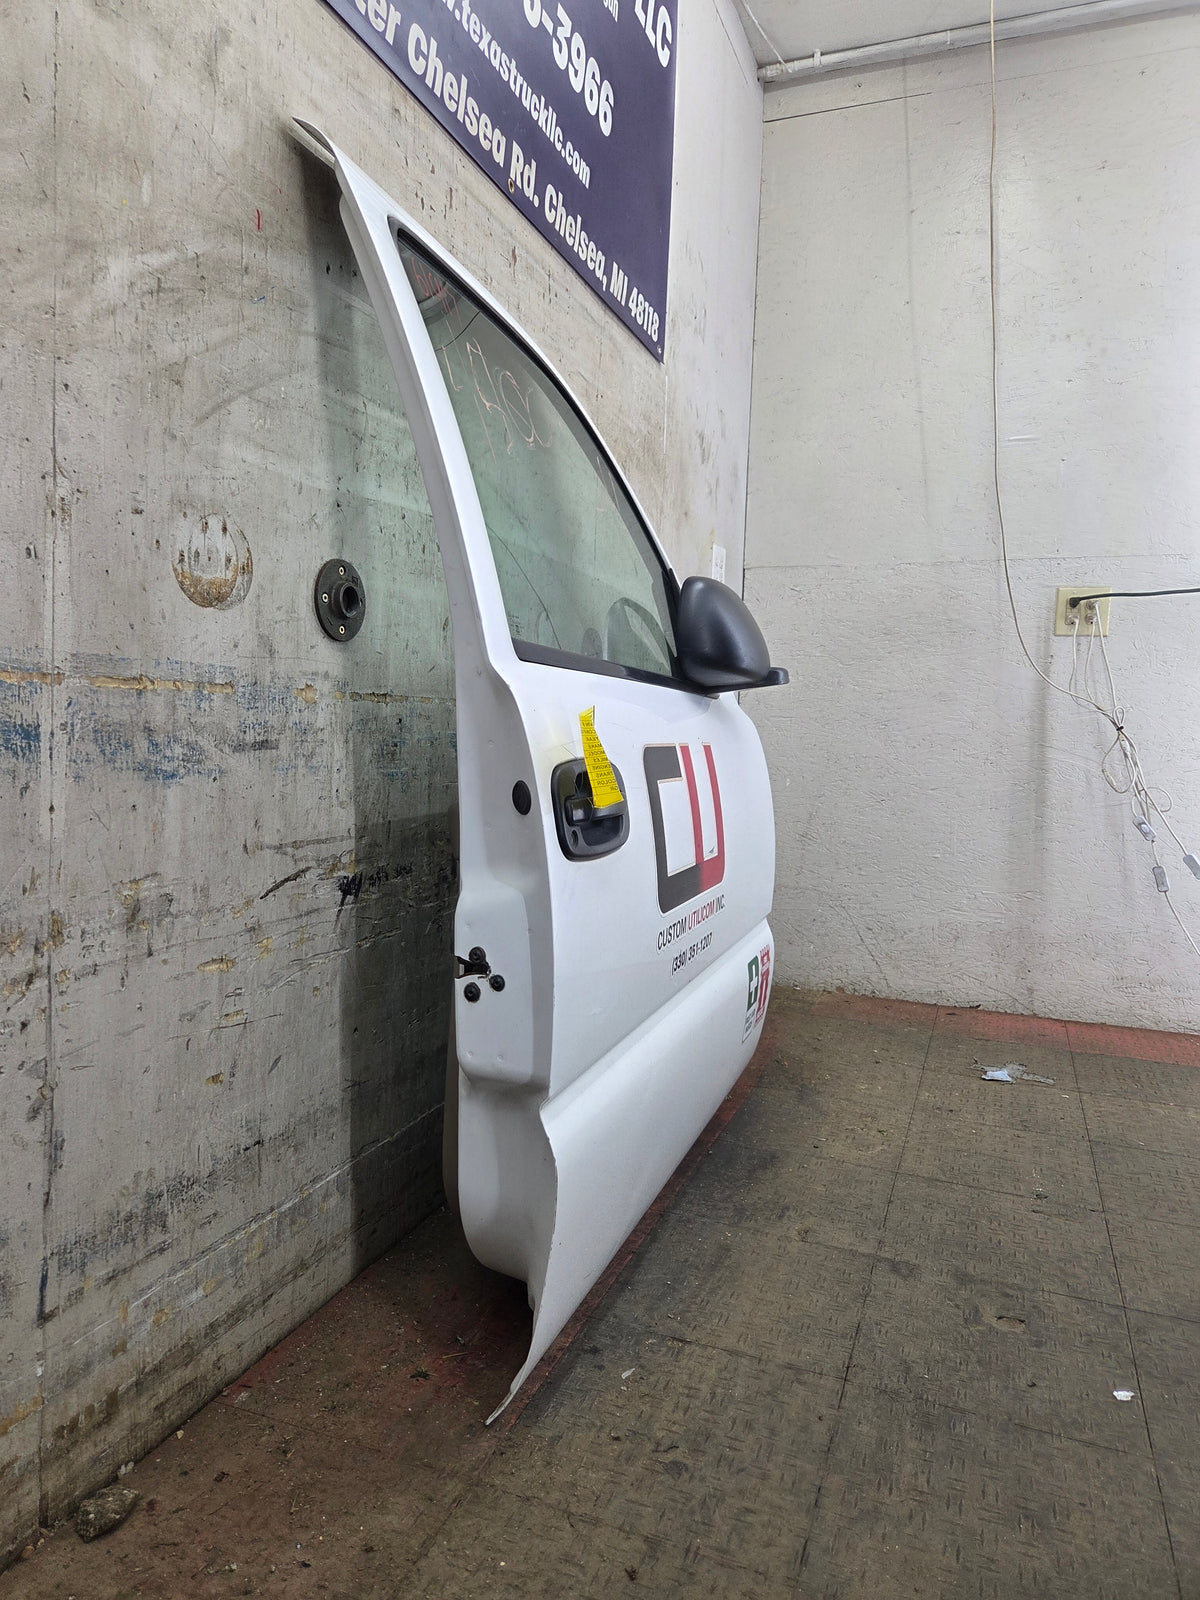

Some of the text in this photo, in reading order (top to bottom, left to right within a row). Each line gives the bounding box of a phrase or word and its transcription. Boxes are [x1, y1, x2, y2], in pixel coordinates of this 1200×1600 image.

[442, 0, 591, 189] .texastruckllc.com
[407, 22, 507, 168] Chelsea
[509, 139, 539, 208] Rd.
[544, 183, 608, 292] Chelsea,
[609, 261, 629, 307] MI
[628, 286, 660, 343] 48118
[657, 916, 687, 951] CUSTOM
[688, 899, 716, 930] UTILICOM
[671, 948, 688, 976] (330)
